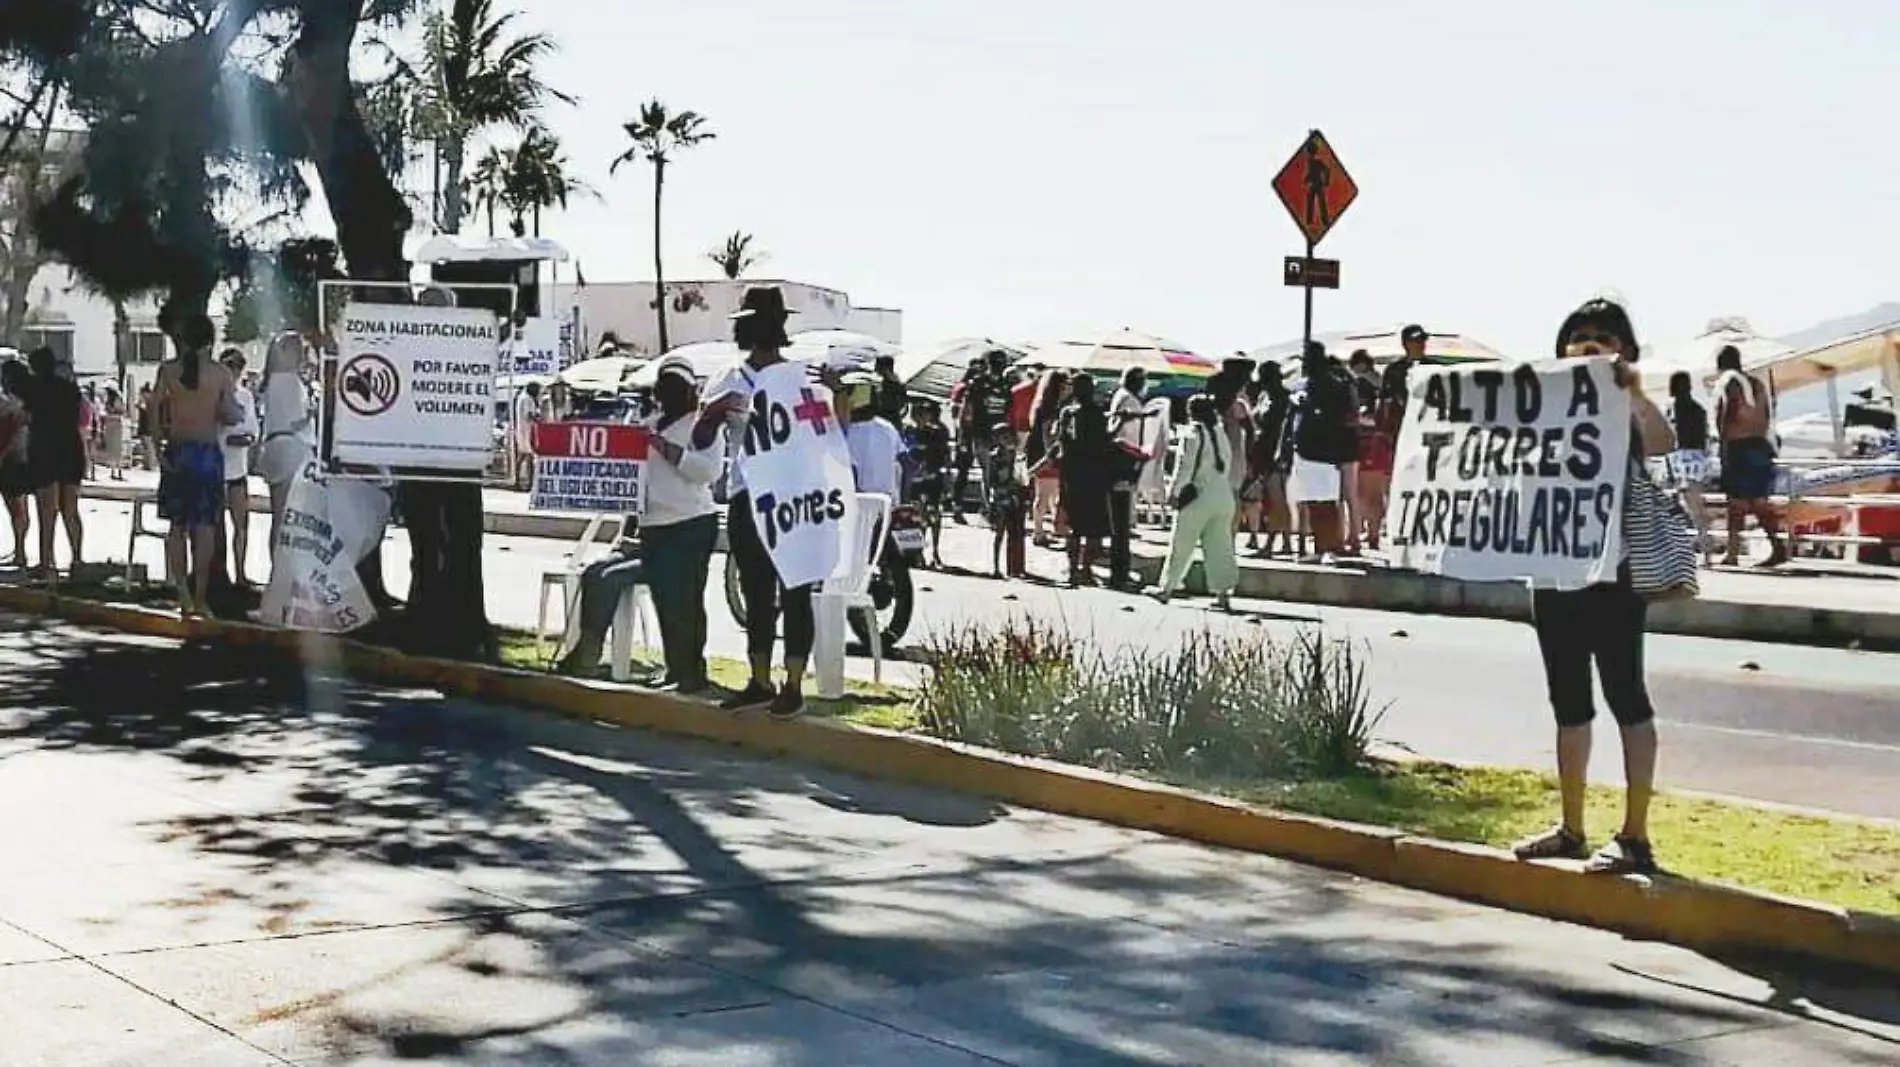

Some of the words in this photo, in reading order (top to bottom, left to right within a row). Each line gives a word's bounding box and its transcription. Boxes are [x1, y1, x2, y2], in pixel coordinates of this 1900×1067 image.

[346, 319, 386, 334] ZONA
[390, 321, 495, 339] HABITACIONAL
[412, 360, 441, 374] POR
[445, 362, 491, 375] FAVOR
[411, 380, 472, 396] MODERE
[475, 382, 490, 395] EL
[1418, 363, 1542, 424] ALTO
[1567, 364, 1600, 417] A
[415, 400, 485, 416] VOLUMEN
[569, 426, 608, 456] NO
[1422, 422, 1602, 482] TORRES
[547, 460, 560, 475] LA
[583, 480, 598, 495] DE
[602, 481, 637, 497] SUELO
[756, 488, 845, 550] Torres
[1392, 483, 1615, 559] IRREGULARES
